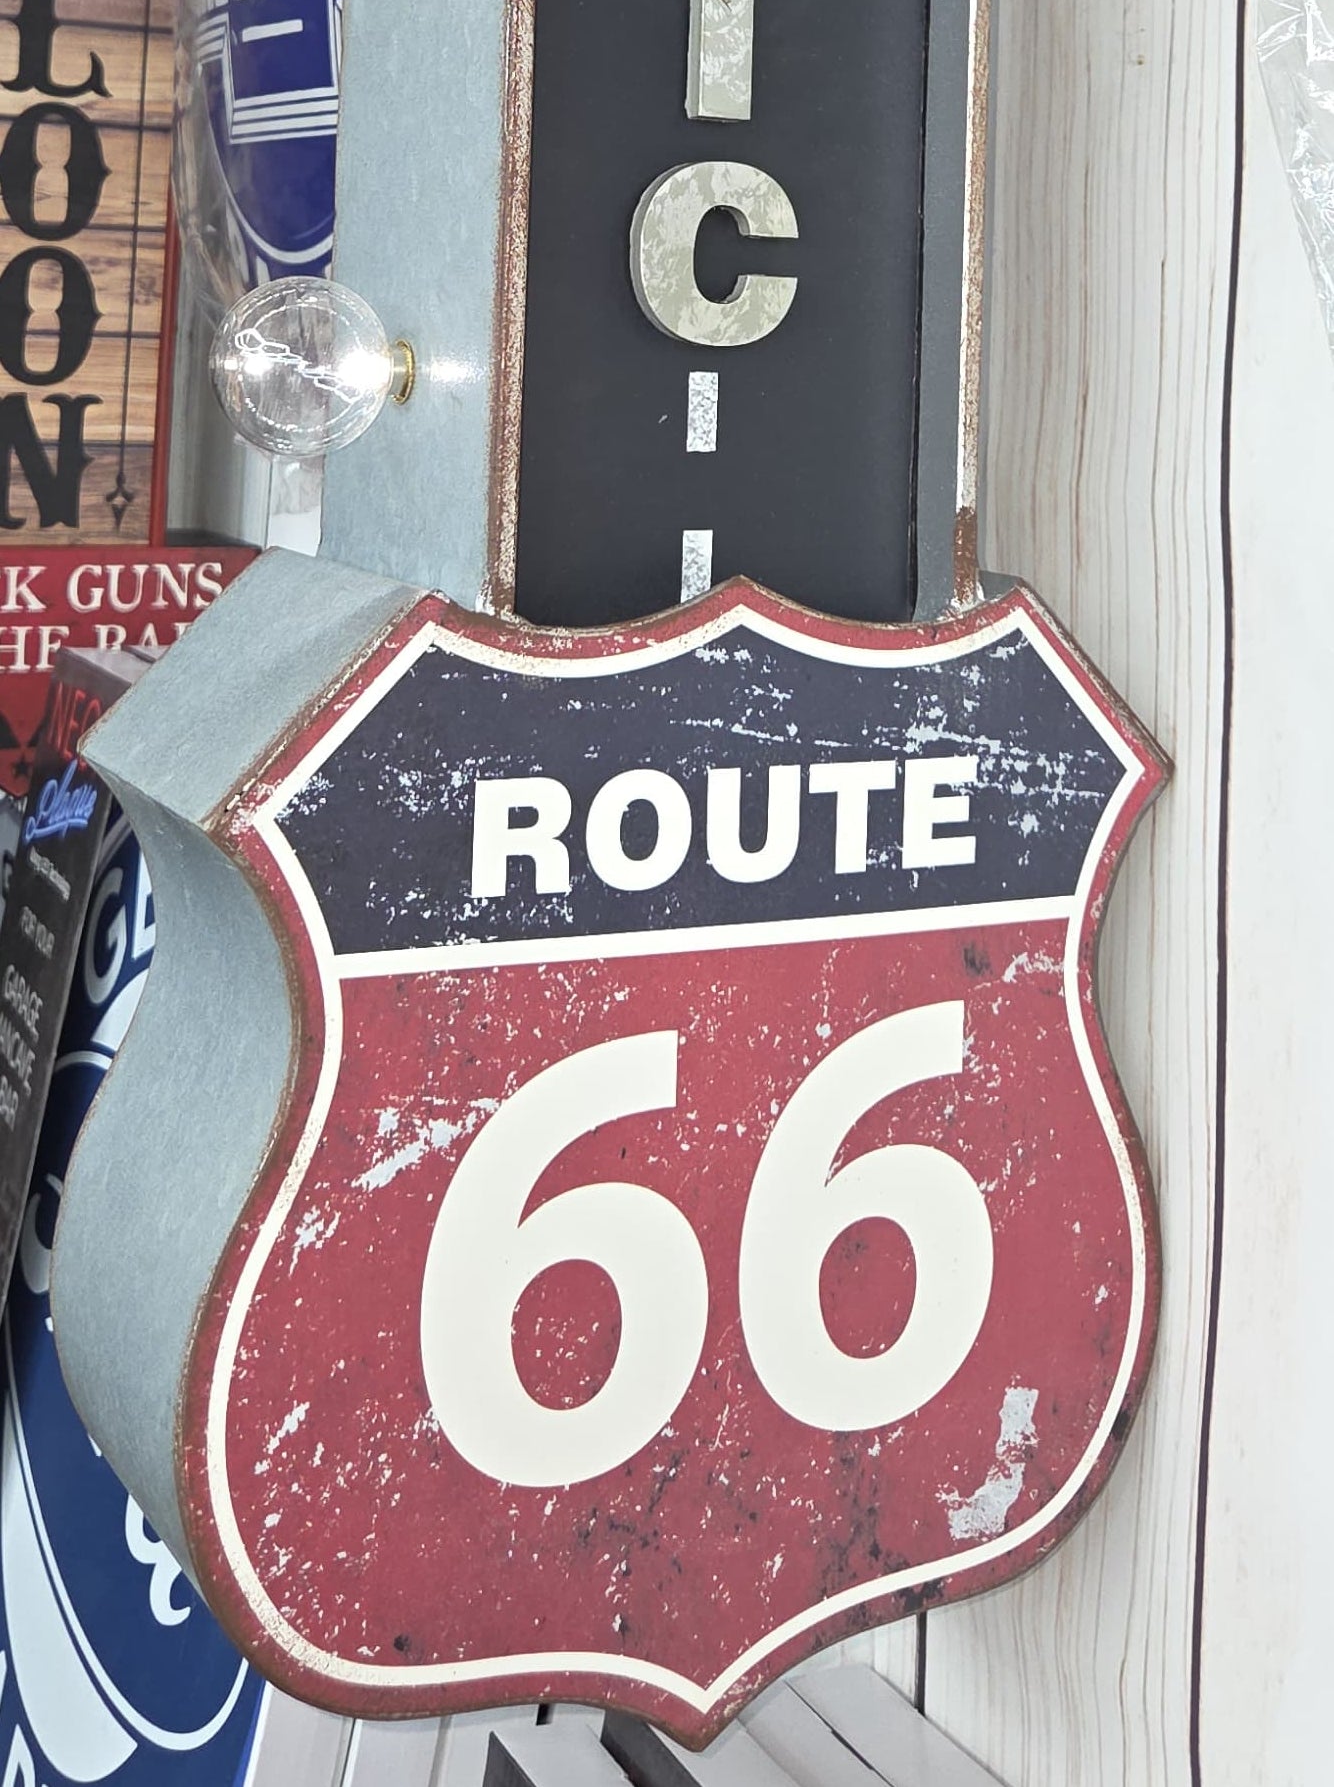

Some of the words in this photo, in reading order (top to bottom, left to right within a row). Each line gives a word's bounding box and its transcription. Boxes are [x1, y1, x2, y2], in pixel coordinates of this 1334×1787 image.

[67, 562, 224, 613] GUNS
[470, 755, 979, 900] ROUTE
[420, 999, 994, 1488] 66
